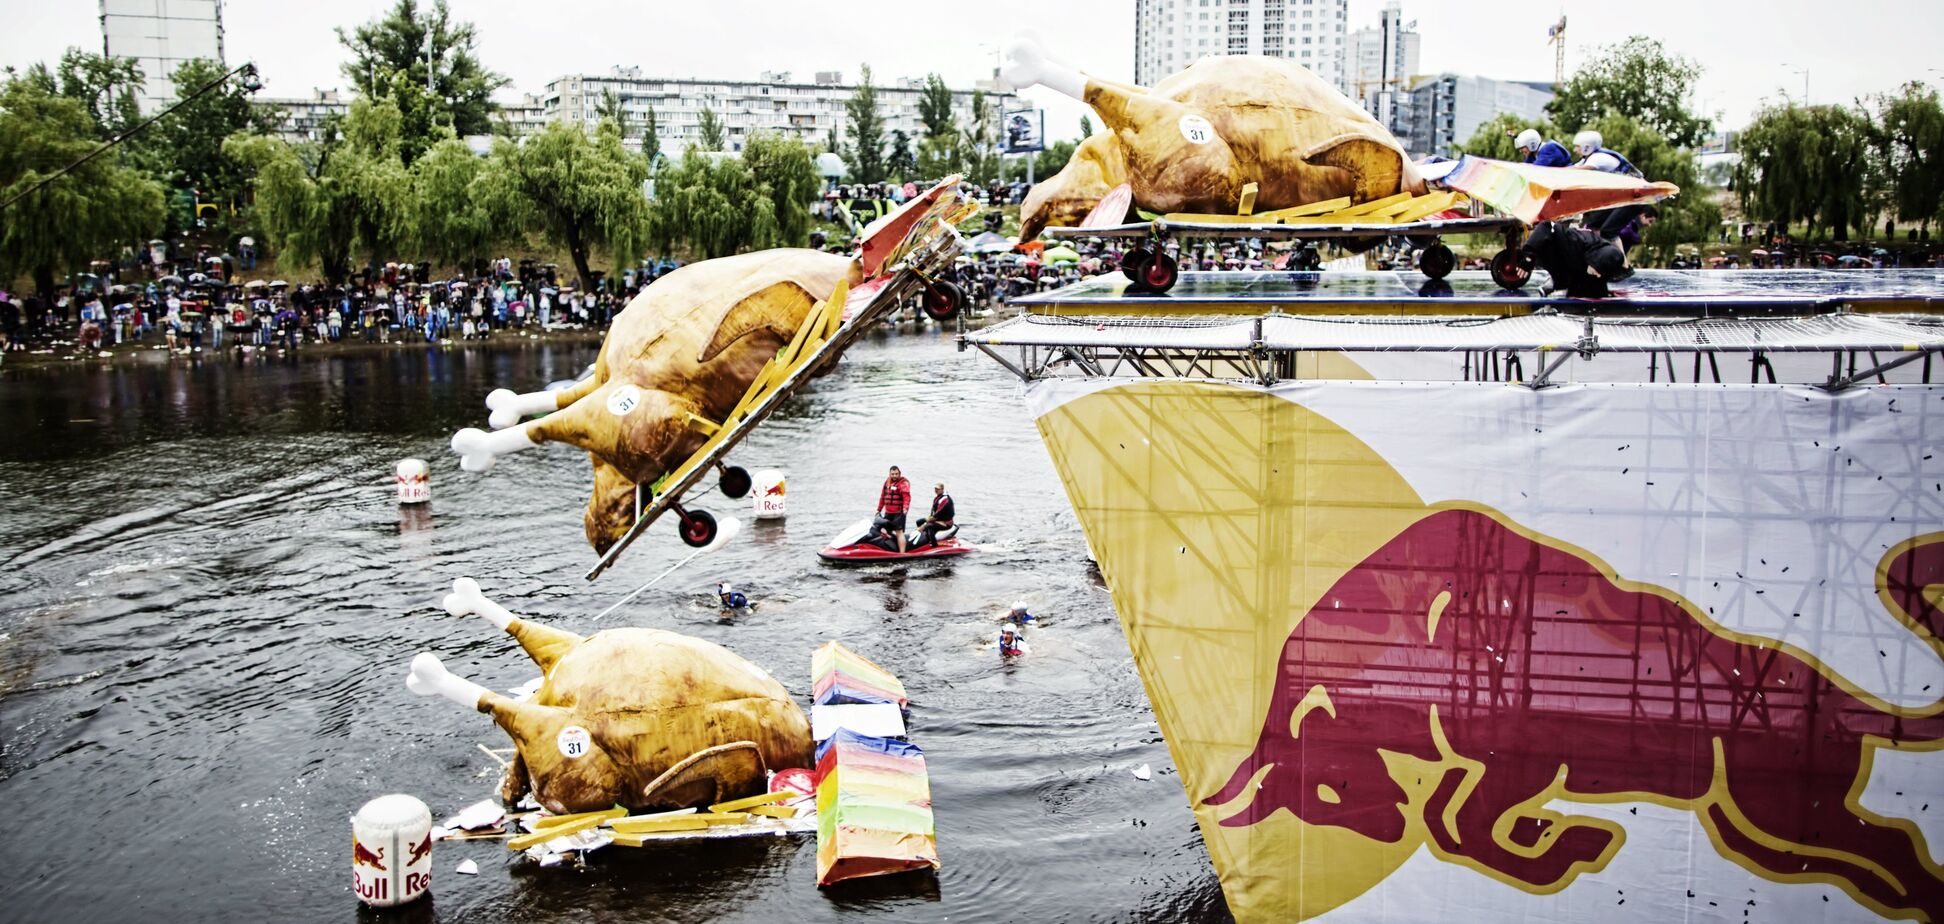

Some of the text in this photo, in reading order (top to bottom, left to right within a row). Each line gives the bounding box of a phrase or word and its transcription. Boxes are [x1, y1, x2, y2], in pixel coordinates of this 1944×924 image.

[1190, 130, 1204, 140] 31
[619, 397, 634, 411] 31
[568, 742, 581, 754] 31
